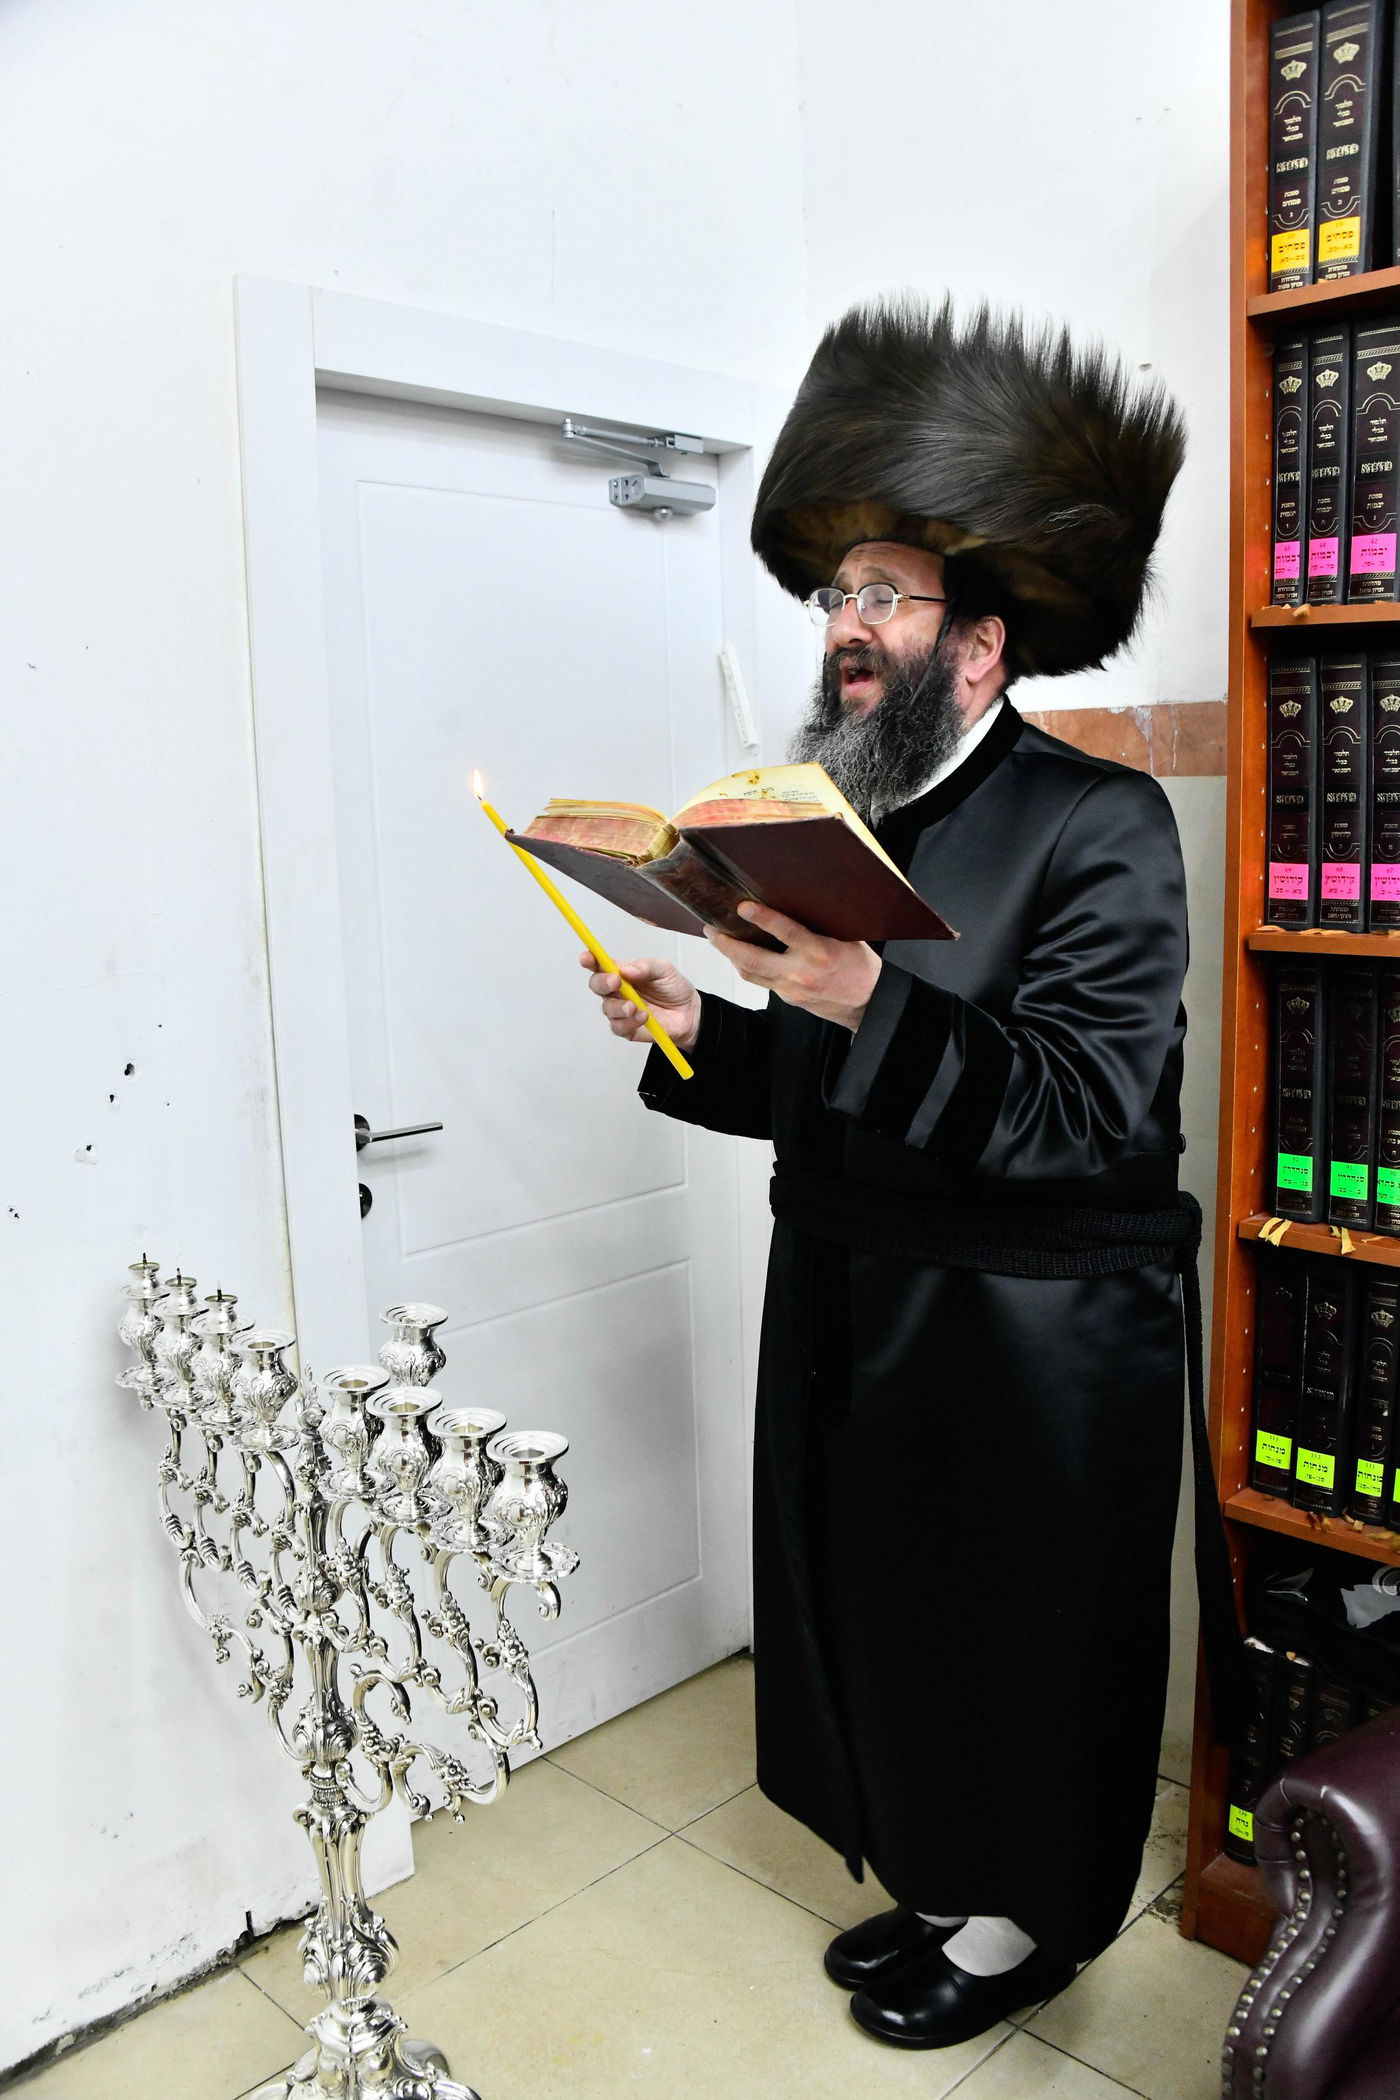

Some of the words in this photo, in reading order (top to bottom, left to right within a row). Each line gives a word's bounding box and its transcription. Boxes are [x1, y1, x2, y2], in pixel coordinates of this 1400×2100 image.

[1327, 230, 1354, 242] פסחים
[1278, 241, 1306, 254] פסחים
[1369, 417, 1387, 426] תלמוד
[1371, 426, 1385, 435] בבלי
[1366, 501, 1385, 510] יבמות
[1311, 550, 1336, 561] יבמות
[1361, 547, 1388, 558] יבמות
[1276, 553, 1301, 564] יבמות
[1386, 757, 1398, 765] בבלי
[1274, 874, 1304, 886] קידושין
[1325, 874, 1356, 886] קידושין
[1374, 875, 1400, 887] ידושין
[1282, 1165, 1309, 1175] סנהדרין
[1337, 1173, 1365, 1183] סנהדרין
[1261, 1442, 1287, 1456] מנחות
[1303, 1460, 1329, 1474] מנחות
[1357, 1469, 1384, 1483] מנחות
[1235, 1816, 1249, 1828] נדה
